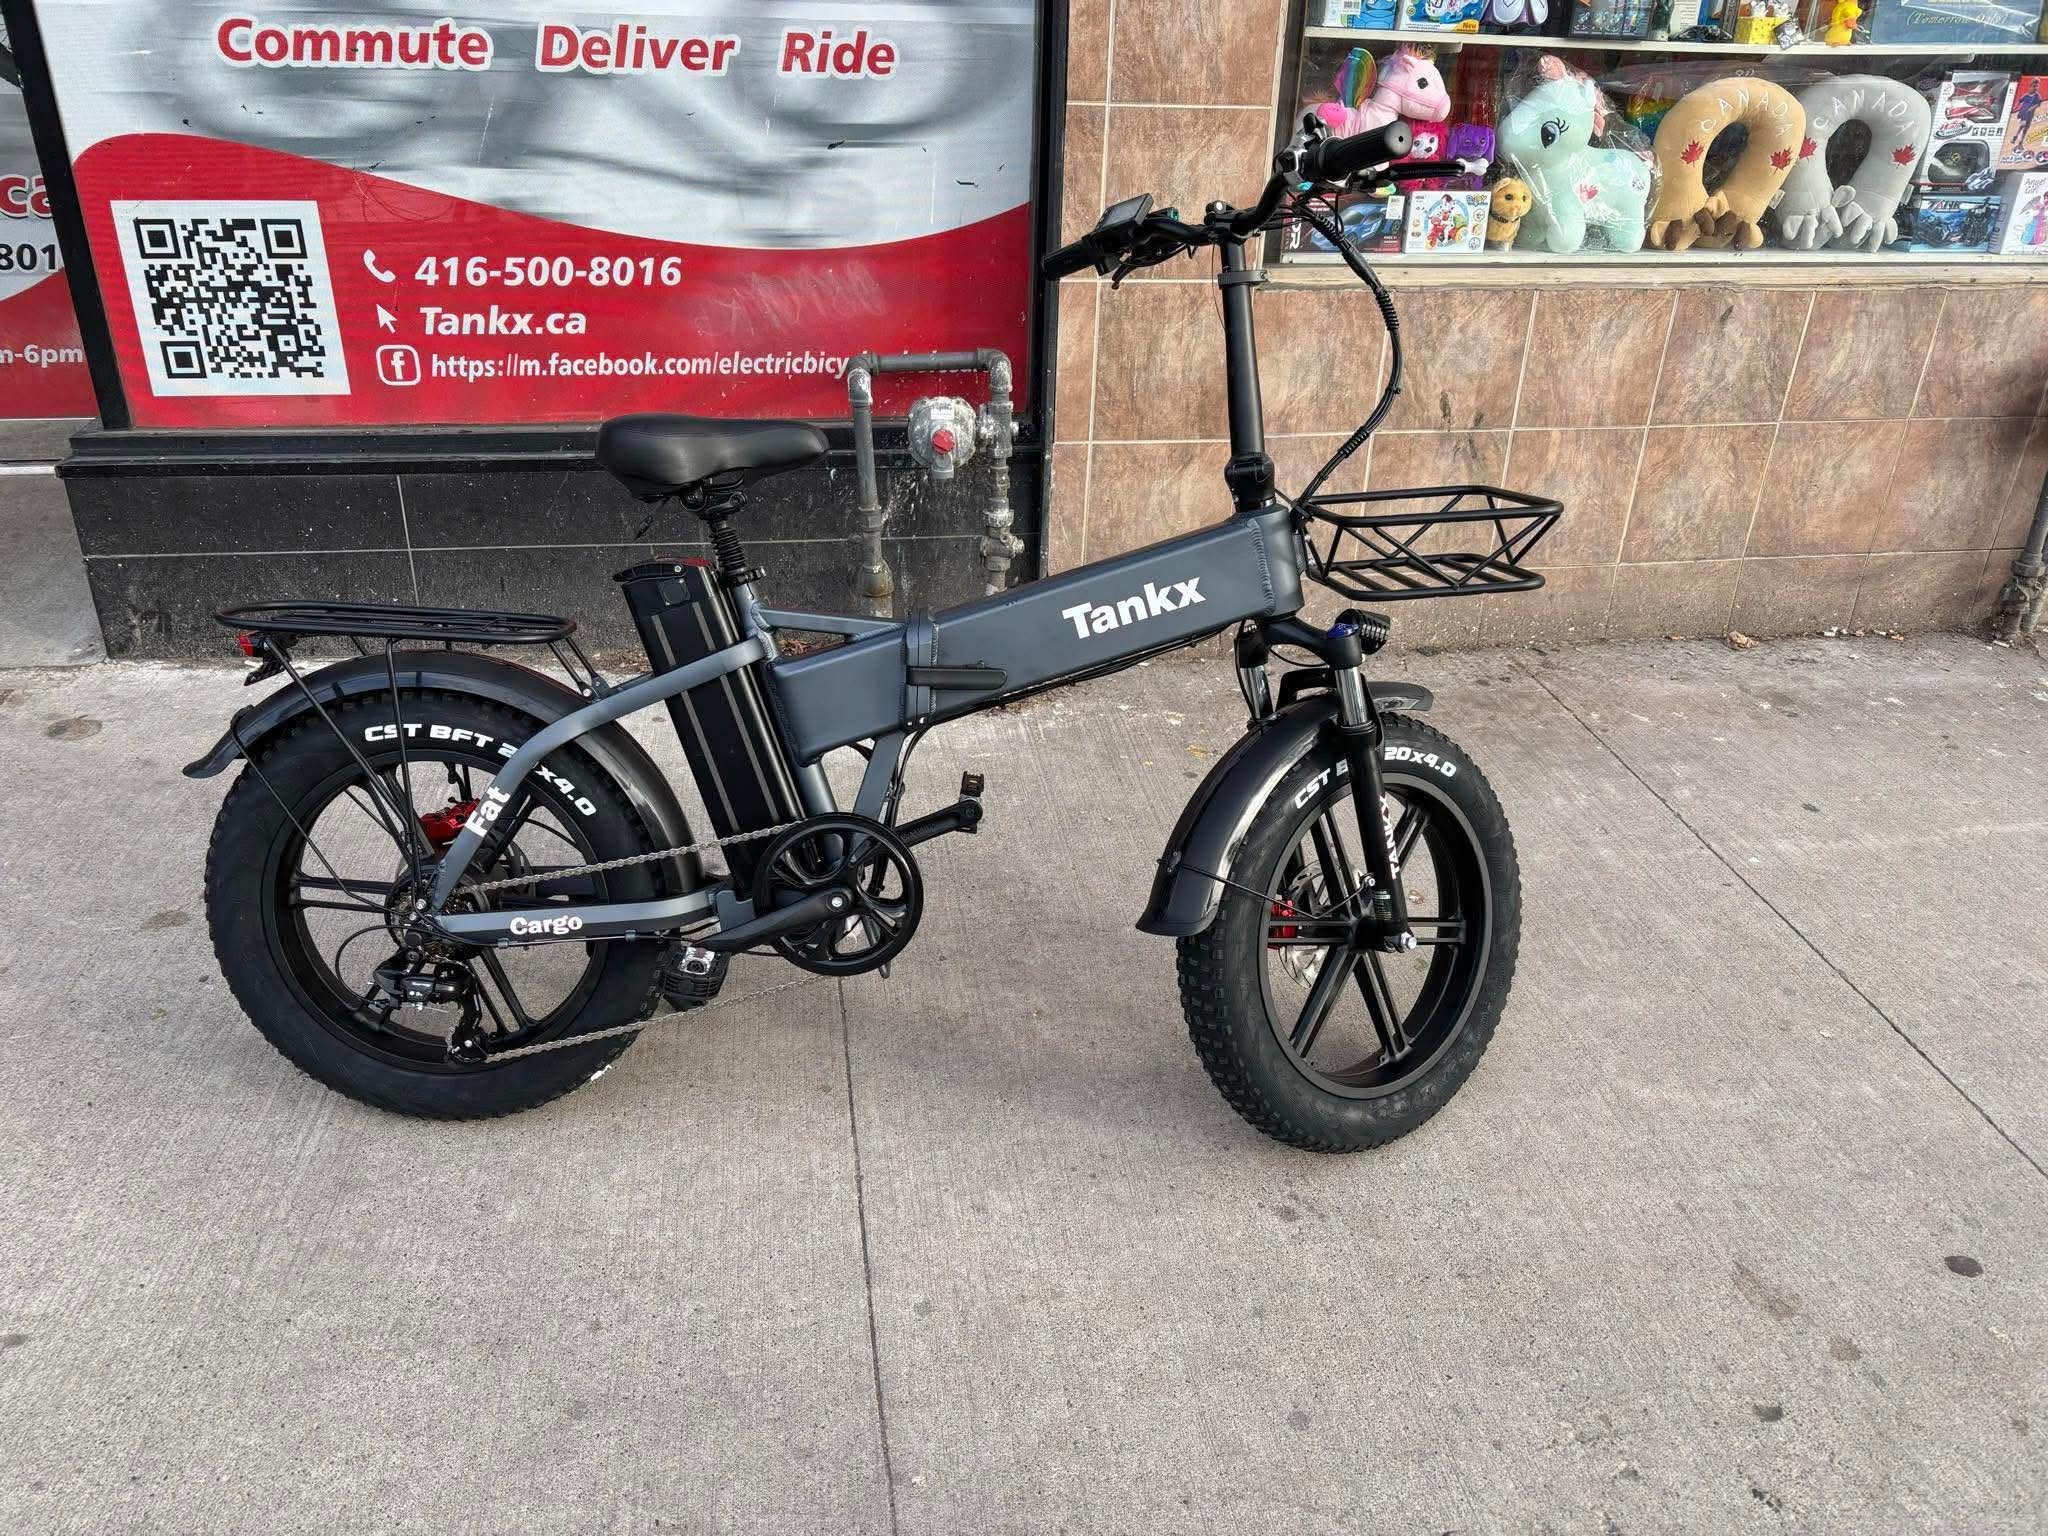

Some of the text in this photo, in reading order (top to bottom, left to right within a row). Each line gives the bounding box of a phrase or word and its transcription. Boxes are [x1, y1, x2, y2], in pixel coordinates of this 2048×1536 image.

[216, 16, 896, 76] Commute Deliver Ride
[1700, 88, 1793, 138] CANADA
[1812, 89, 1915, 136] CANADA
[414, 256, 682, 287] 416-500-8016
[419, 304, 587, 335] Tankx.ca
[431, 351, 849, 382] https://m.facebook.com/electricbicy
[1062, 576, 1206, 639] Tankx
[364, 723, 422, 742] CST
[430, 724, 494, 748] BFT
[1294, 768, 1331, 809] CST
[464, 786, 511, 838] Fat
[510, 915, 583, 936] Cargo
